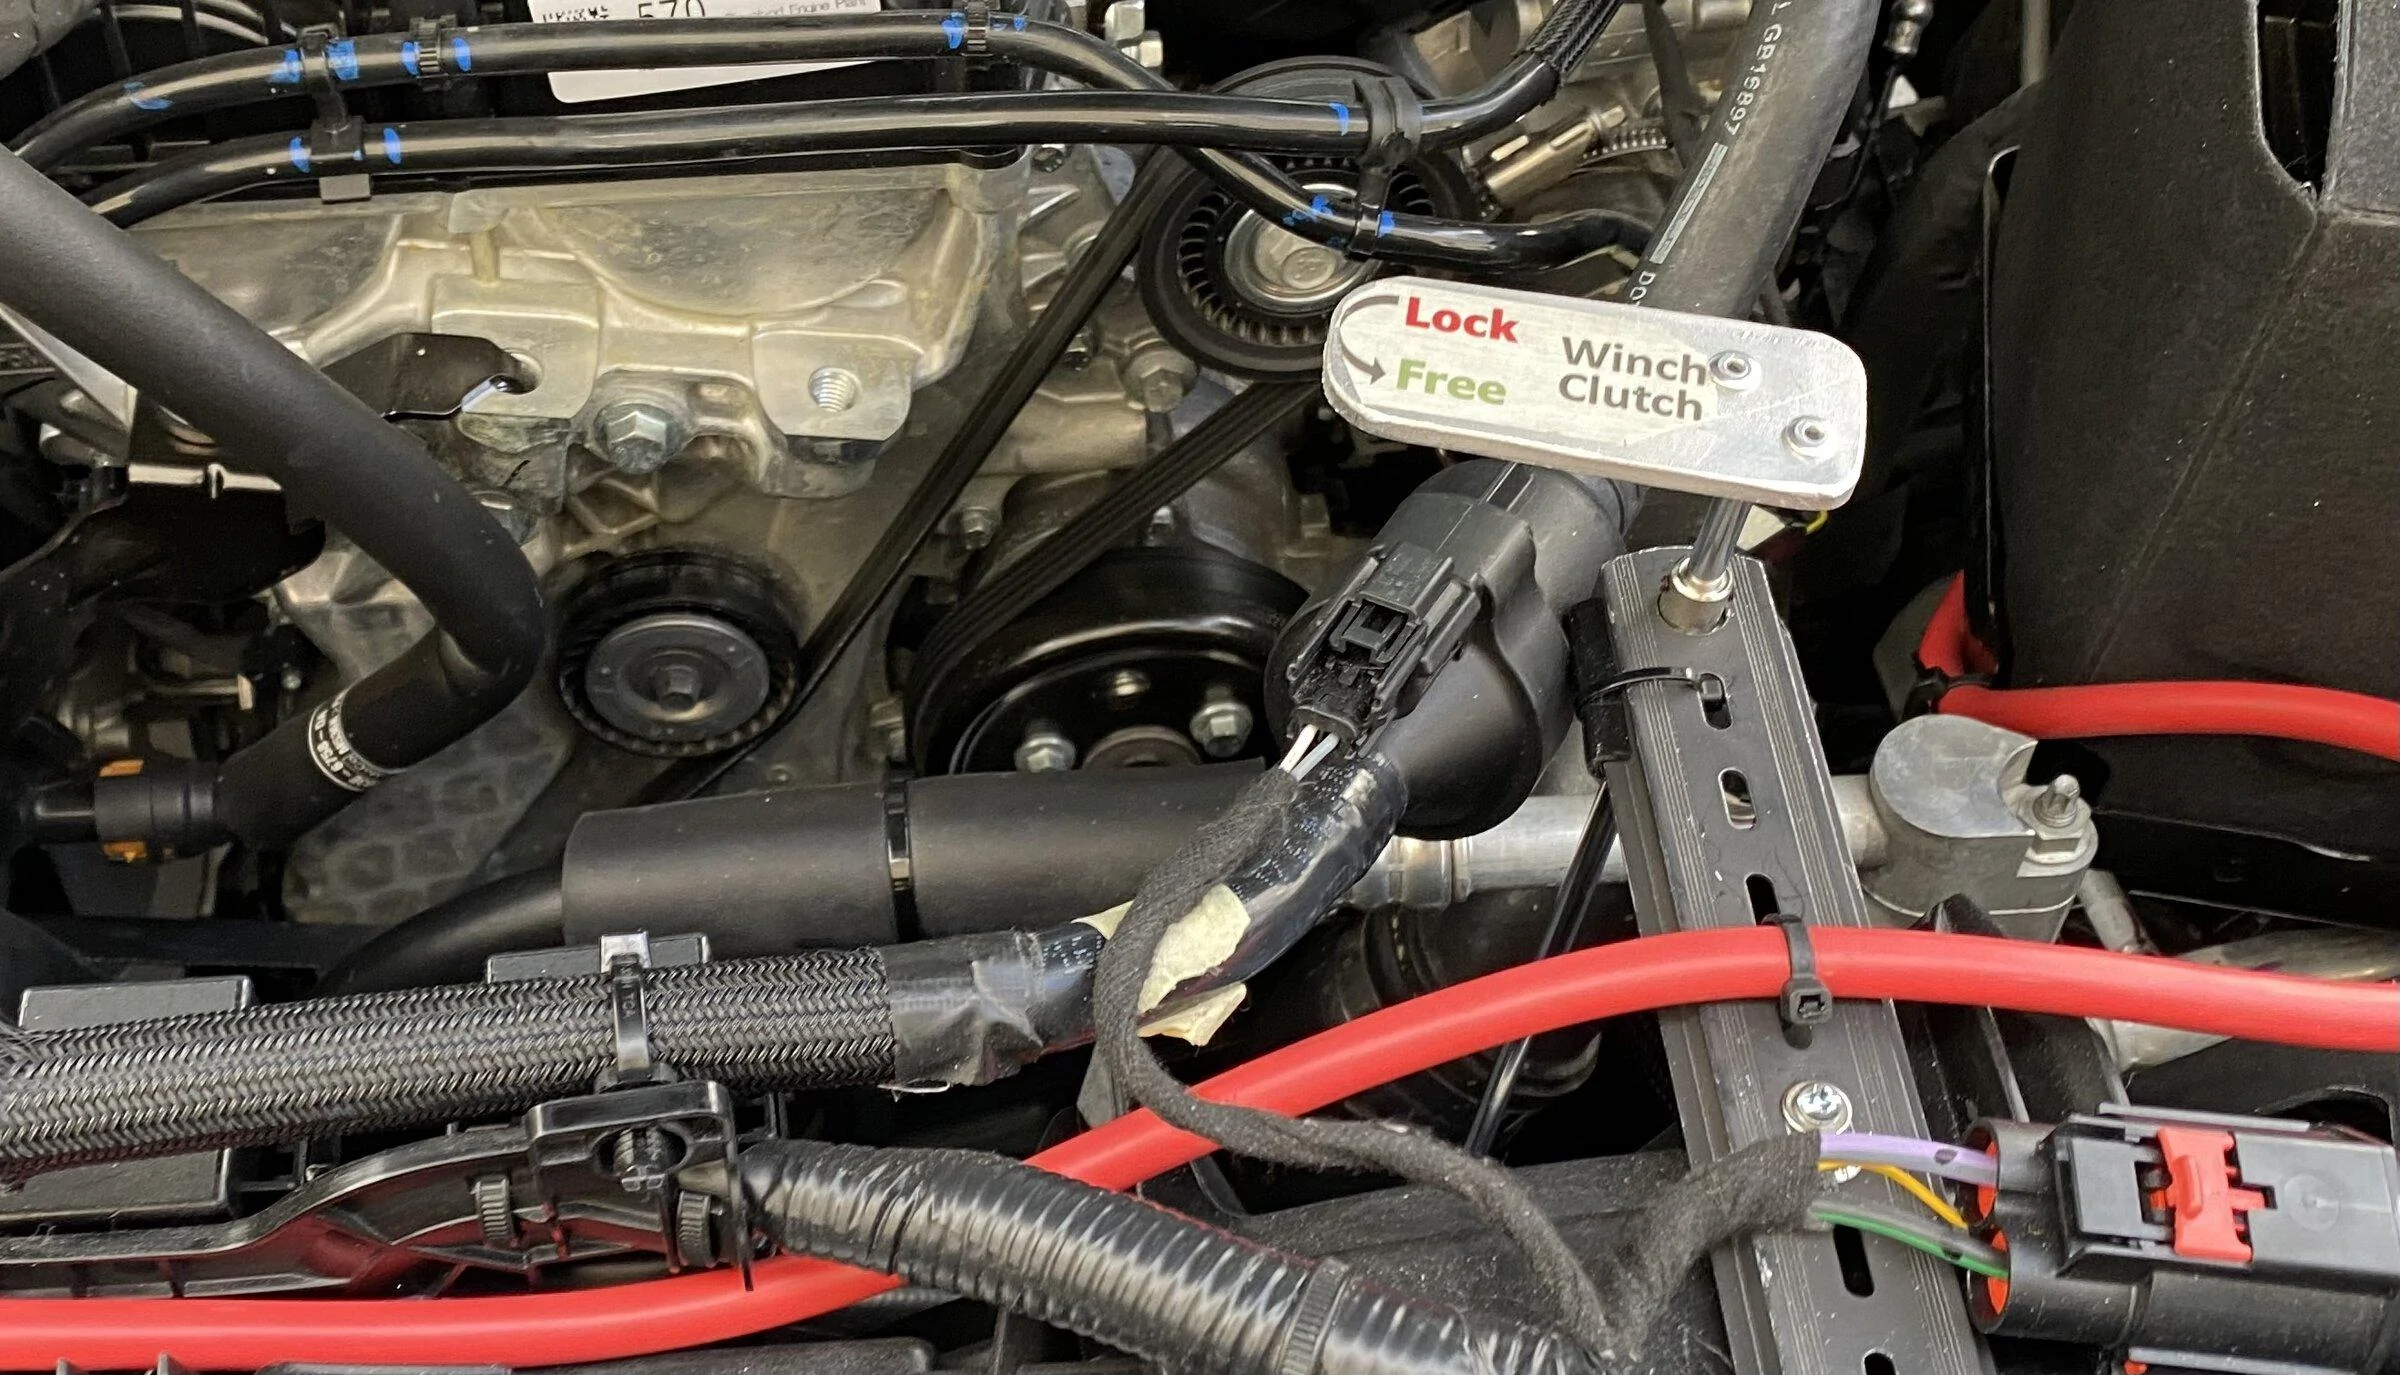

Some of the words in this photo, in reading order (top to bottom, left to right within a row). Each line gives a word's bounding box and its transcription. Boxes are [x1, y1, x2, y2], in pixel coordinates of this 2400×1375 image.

[1629, 270, 1656, 306] DO
[1405, 297, 1519, 343] Lock
[1396, 359, 1506, 404] Free
[1562, 336, 1707, 386] Winch
[1559, 374, 1704, 421] Clutch
